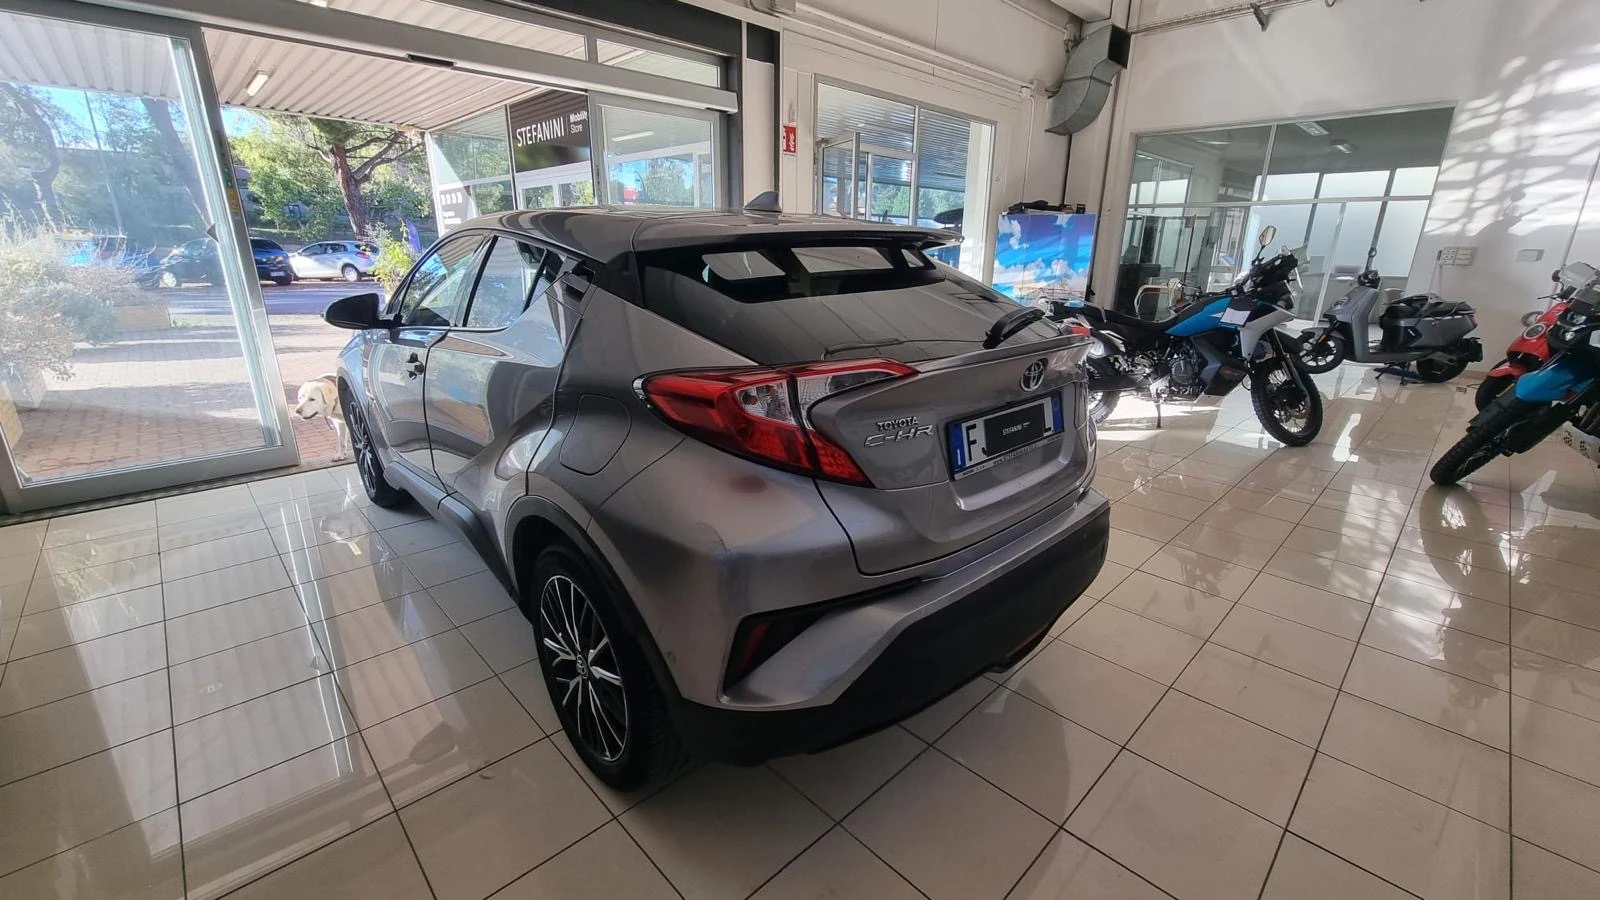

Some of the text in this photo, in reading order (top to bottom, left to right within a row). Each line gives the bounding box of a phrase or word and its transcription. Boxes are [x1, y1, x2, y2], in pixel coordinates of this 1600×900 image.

[516, 116, 565, 147] STEFANINI
[570, 124, 583, 134] Store
[876, 416, 918, 431] TOYOTA
[864, 424, 933, 447] C-HR
